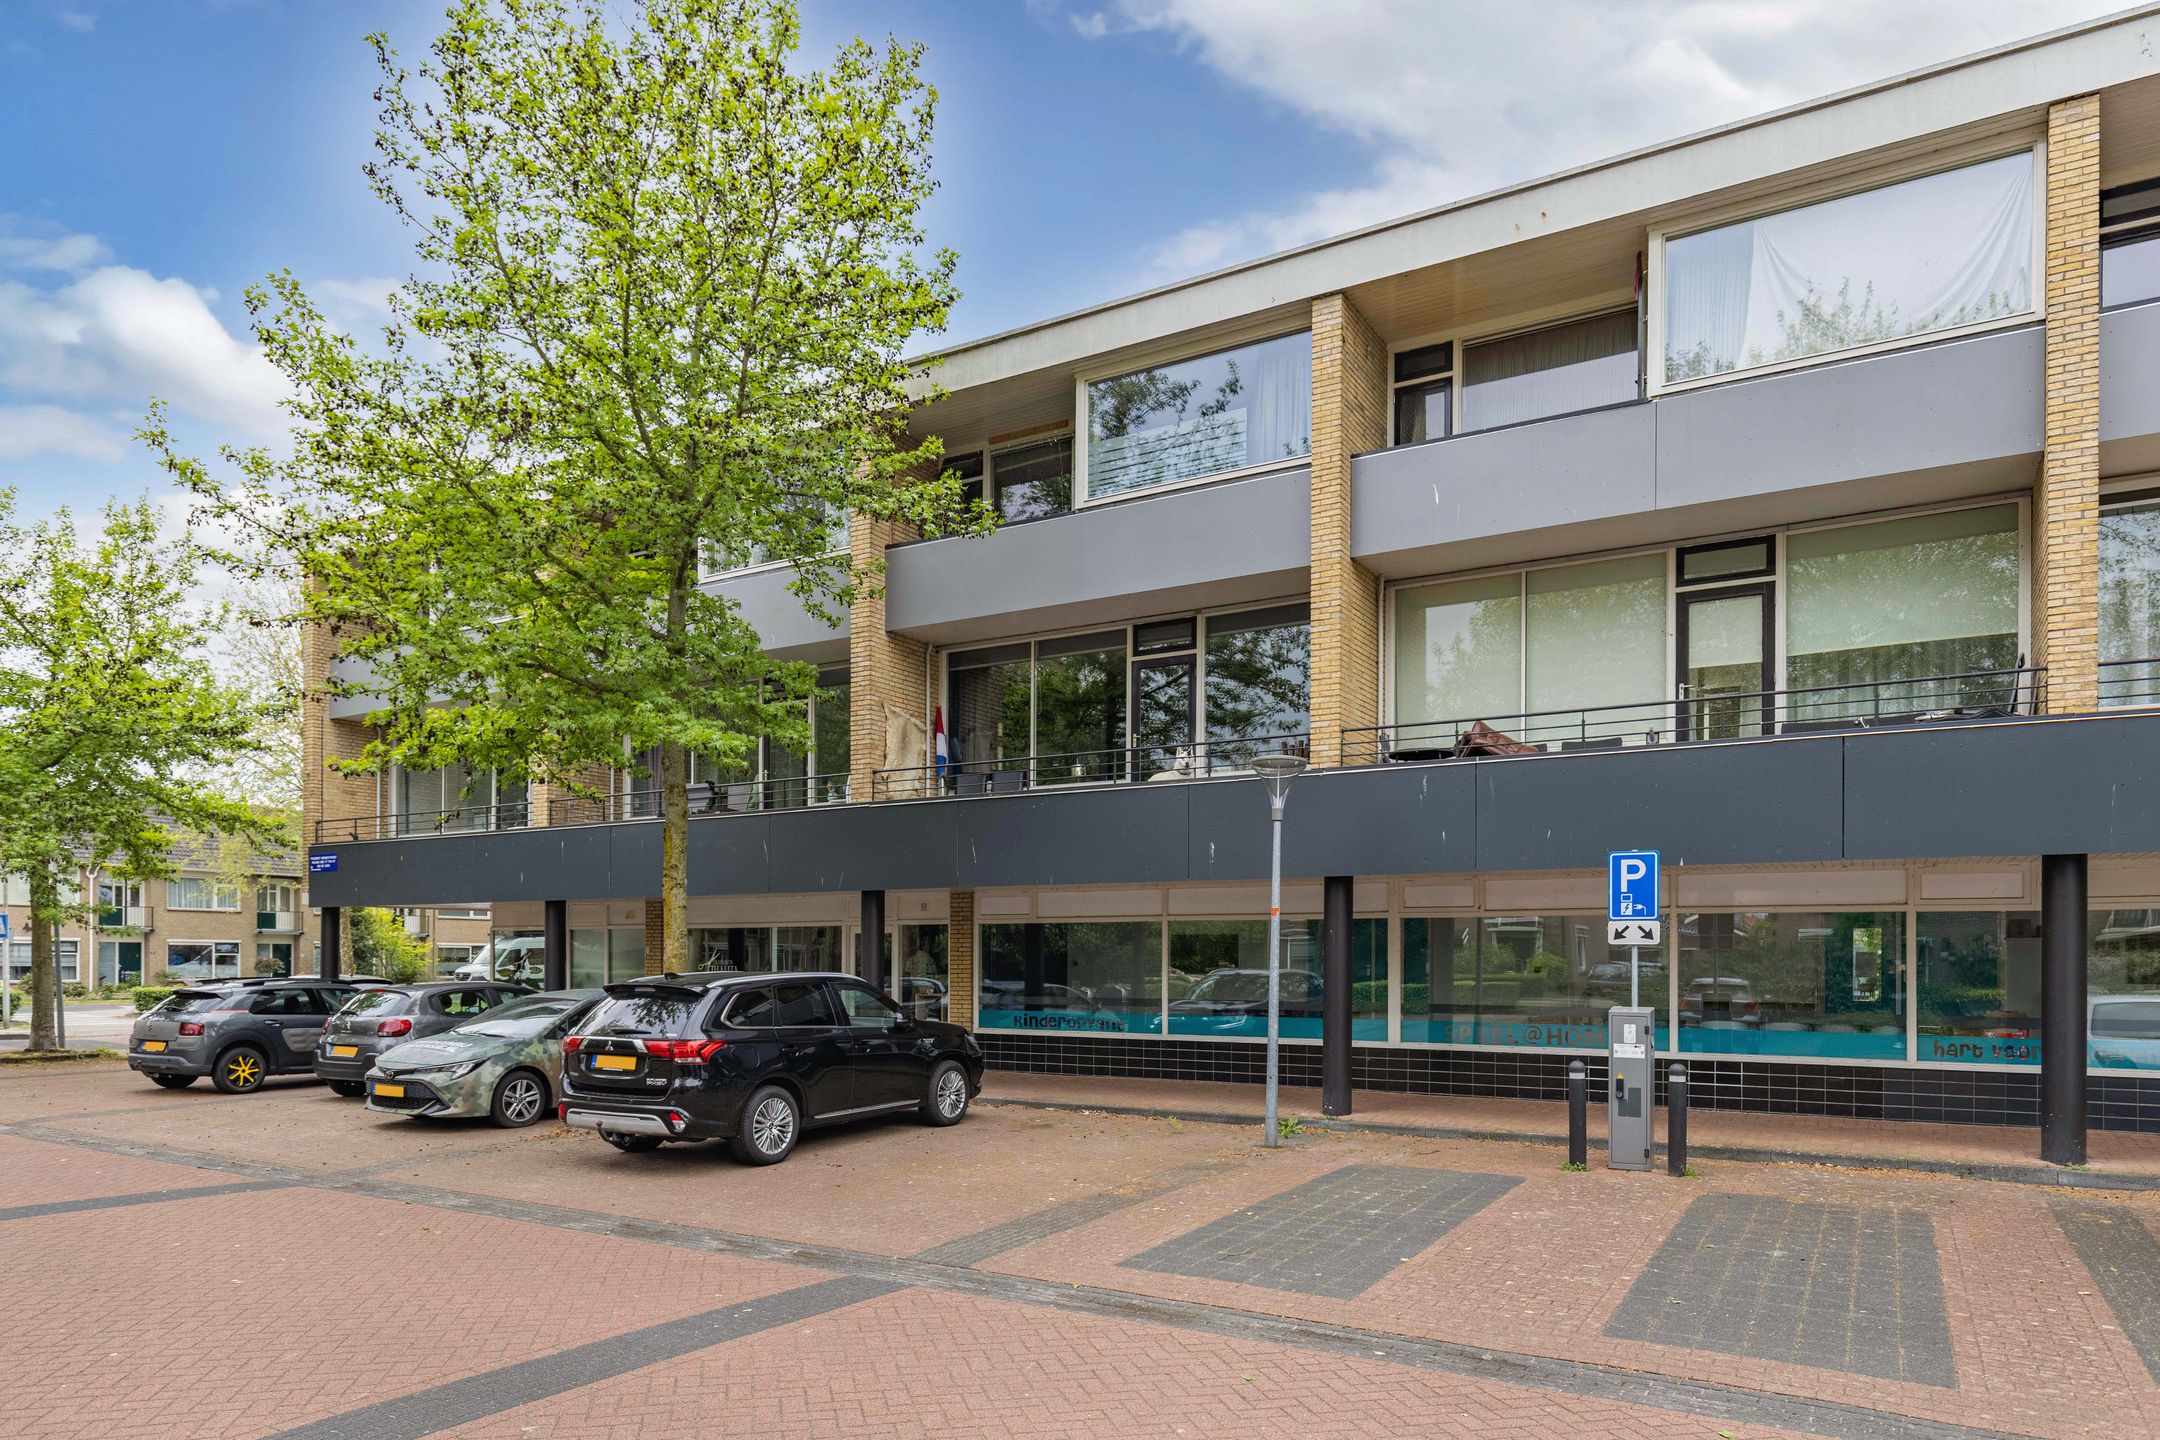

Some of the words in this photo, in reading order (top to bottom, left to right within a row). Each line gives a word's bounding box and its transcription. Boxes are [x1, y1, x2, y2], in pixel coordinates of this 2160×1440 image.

[1621, 859, 1646, 892] P
[1934, 1040, 1983, 1058] hart
[1992, 1045, 2041, 1060] voor
